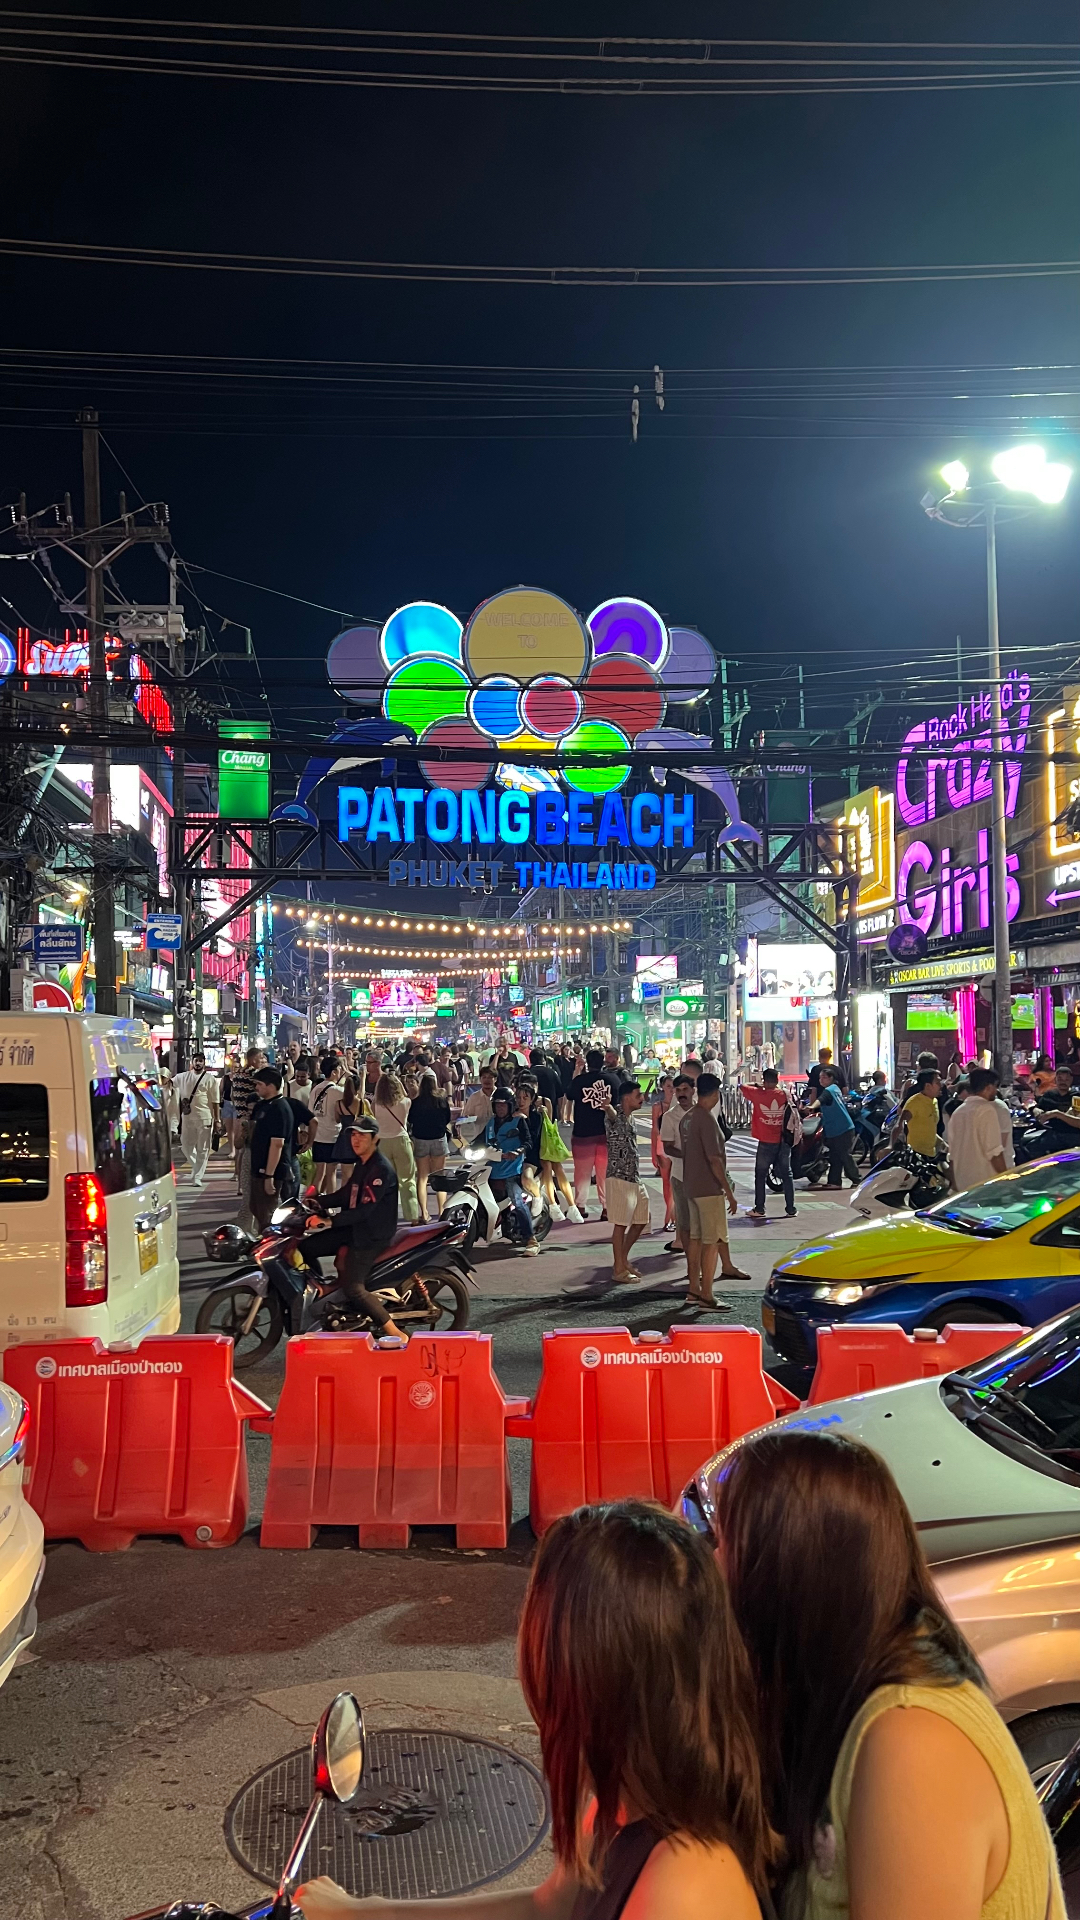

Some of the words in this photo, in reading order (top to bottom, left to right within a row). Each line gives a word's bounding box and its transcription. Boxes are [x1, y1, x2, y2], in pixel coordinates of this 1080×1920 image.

[484, 612, 569, 628] WELCOME
[517, 634, 538, 649] TO
[928, 702, 968, 742] Rock
[970, 668, 1031, 729] Had's
[221, 750, 266, 767] Chang
[896, 703, 1032, 827] Crazy
[338, 786, 530, 845] PATONG
[535, 790, 695, 849] BEACH
[388, 860, 503, 888] PHUKET
[514, 861, 657, 891] THAILAND
[898, 969, 918, 982] OSCAR
[918, 967, 930, 980] BAR
[931, 965, 946, 978] LIVE
[946, 962, 971, 976] SPORTS
[979, 956, 996, 971] POO
[603, 1347, 723, 1365] เทศบาลเมืองป่าตอง
[58, 1359, 183, 1377] เทศบาลเมืองป่าตอง
